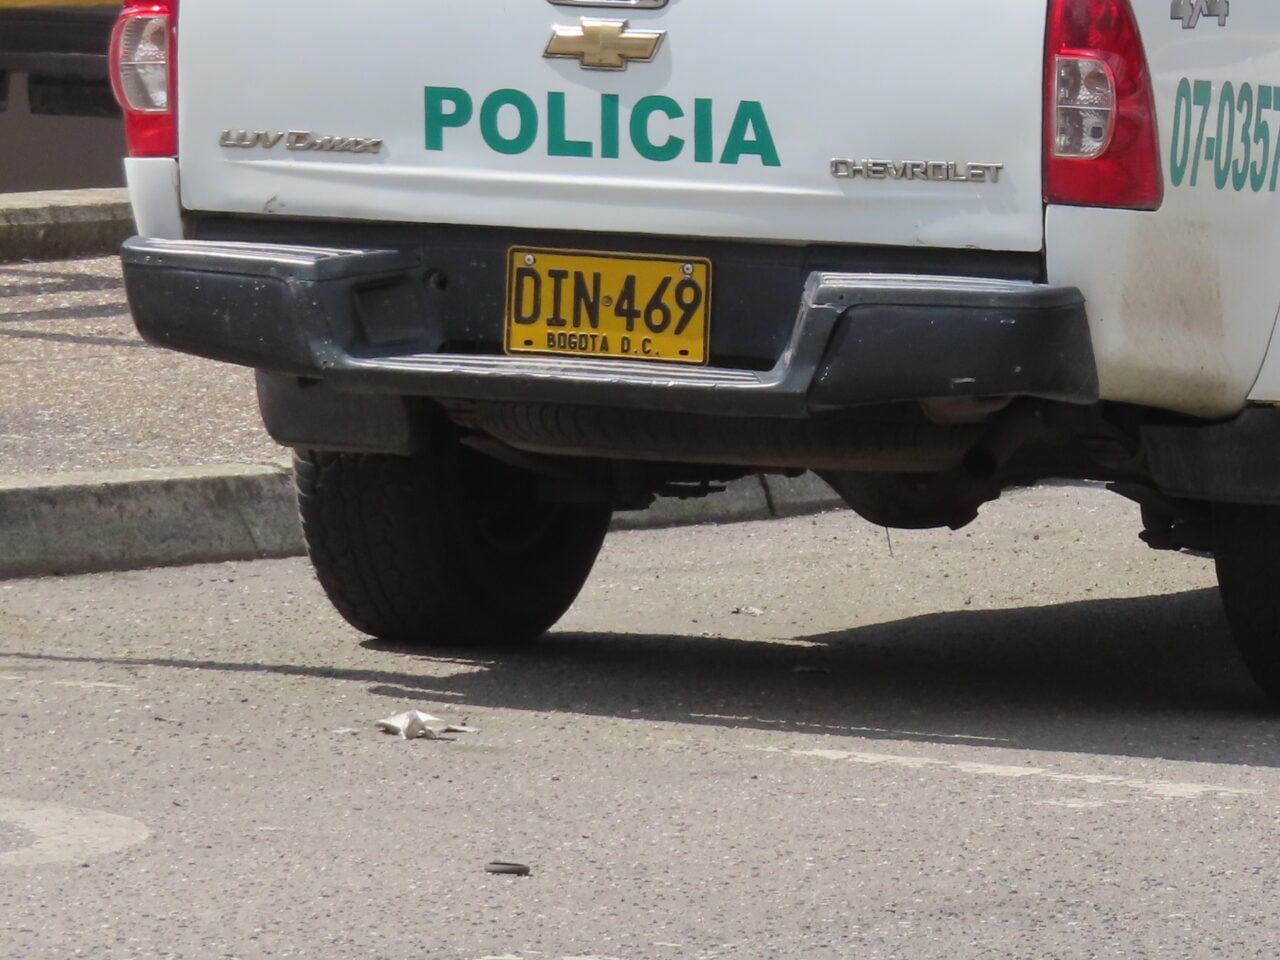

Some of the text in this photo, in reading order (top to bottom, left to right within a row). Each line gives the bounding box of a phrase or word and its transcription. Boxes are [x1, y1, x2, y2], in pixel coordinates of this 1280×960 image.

[219, 129, 284, 149] LUV
[424, 86, 782, 167] POLICIA
[830, 158, 1004, 183] CHEVROLET
[514, 267, 702, 335] DIN 469
[546, 332, 660, 356] BOGOTA D.C.
